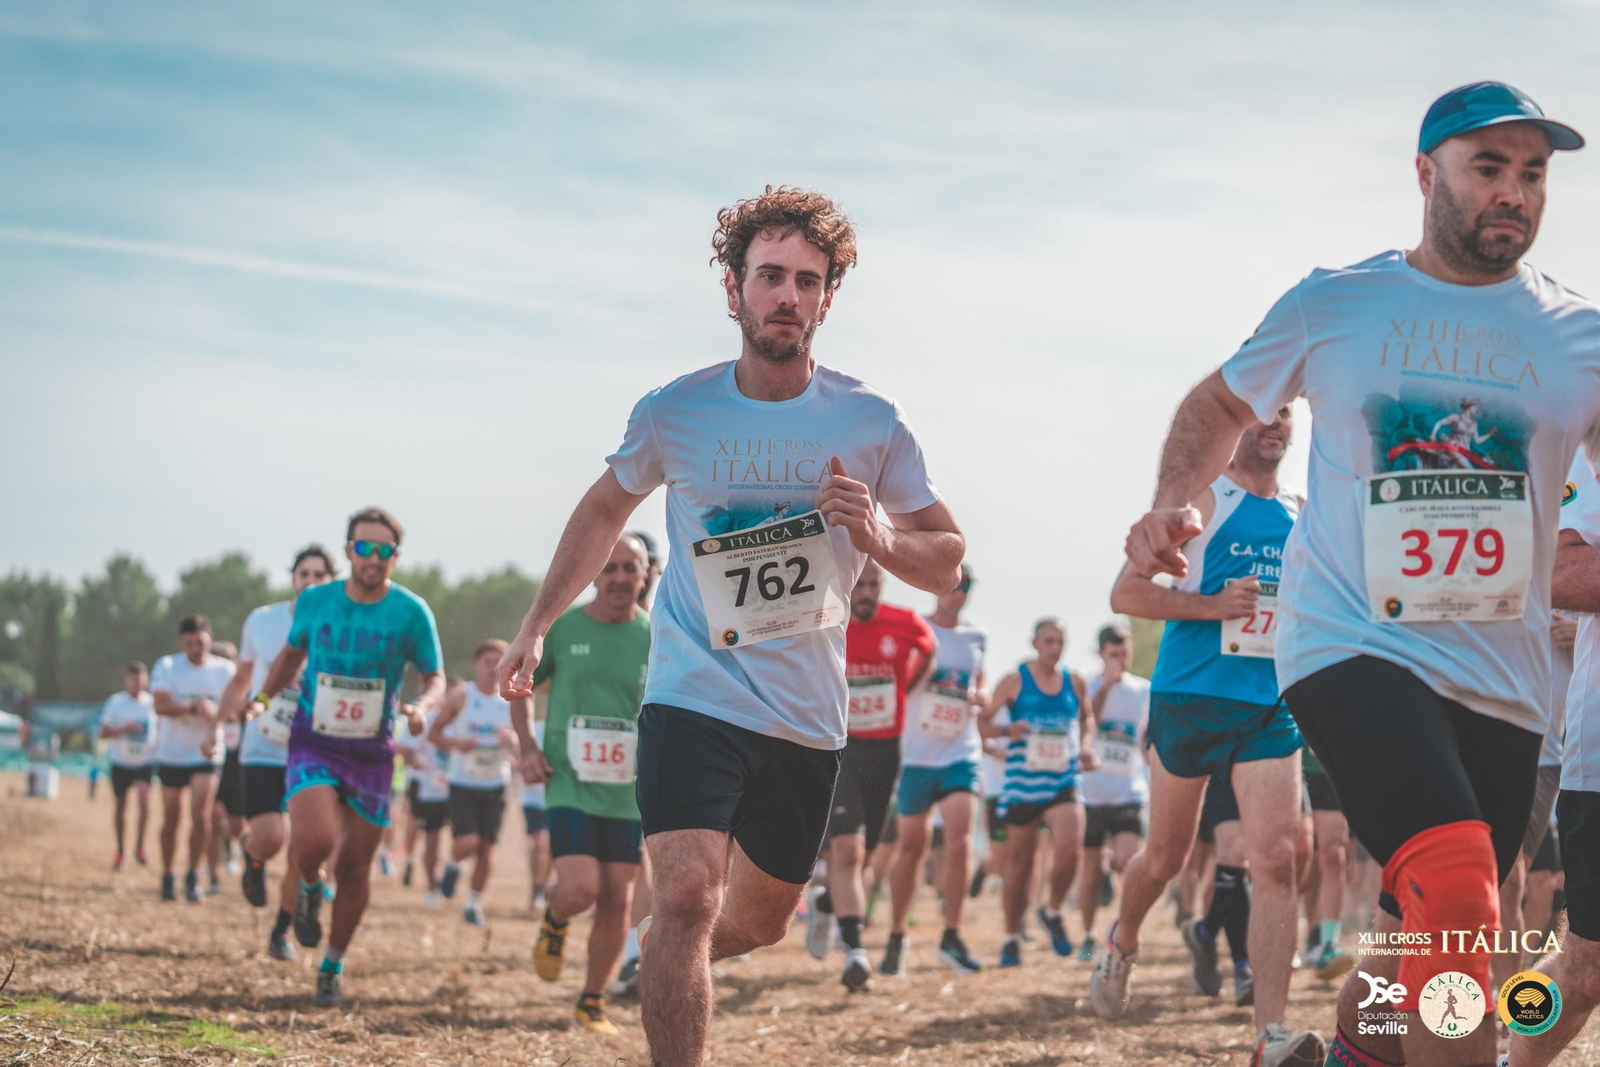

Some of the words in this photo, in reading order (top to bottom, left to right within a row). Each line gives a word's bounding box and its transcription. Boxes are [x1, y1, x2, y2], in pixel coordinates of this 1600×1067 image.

[1462, 324, 1522, 346] CROSS
[773, 439, 822, 451] CROSS
[711, 454, 833, 483] ITÁLICA
[1411, 475, 1489, 496] ITÁLICA
[729, 526, 793, 547] ITÁLICA
[726, 550, 752, 560] ALBERTO
[753, 546, 779, 555] ESTEBAN
[742, 550, 787, 563] INDEPENDIENTE
[1262, 546, 1281, 559] CH
[1401, 528, 1505, 577] 379
[1249, 562, 1282, 578] JERE
[725, 556, 815, 607] 762
[1241, 610, 1277, 635] 27
[334, 701, 364, 721] 26
[582, 741, 625, 764] 116
